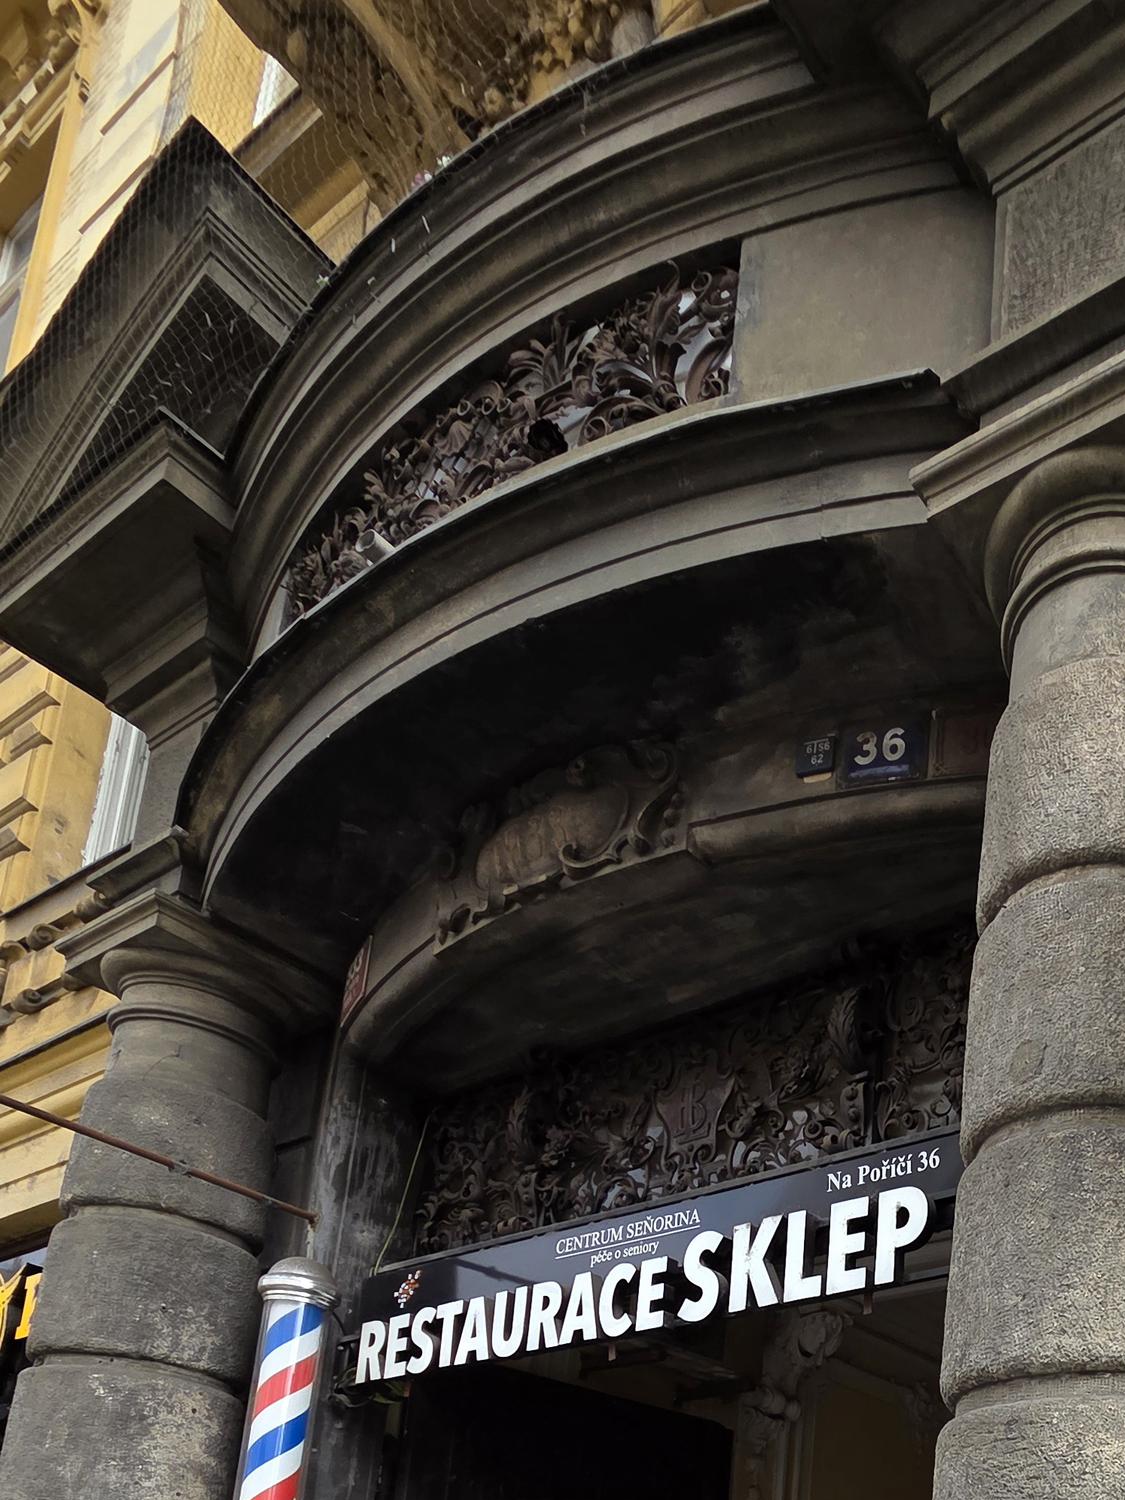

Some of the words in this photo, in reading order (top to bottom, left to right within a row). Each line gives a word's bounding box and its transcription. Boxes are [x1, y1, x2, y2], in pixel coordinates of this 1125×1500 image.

[853, 727, 906, 766] 36
[826, 1170, 852, 1193] Na
[857, 1153, 913, 1186] Poříčí
[917, 1147, 940, 1173] 36
[555, 1225, 624, 1255] CENTRUM
[626, 1208, 701, 1239] SEŇORINA
[590, 1249, 613, 1268] péče
[614, 1249, 621, 1259] o
[622, 1240, 660, 1259] seniory
[354, 1254, 669, 1385] RESTAURACE
[677, 1184, 930, 1323] SKLEP
